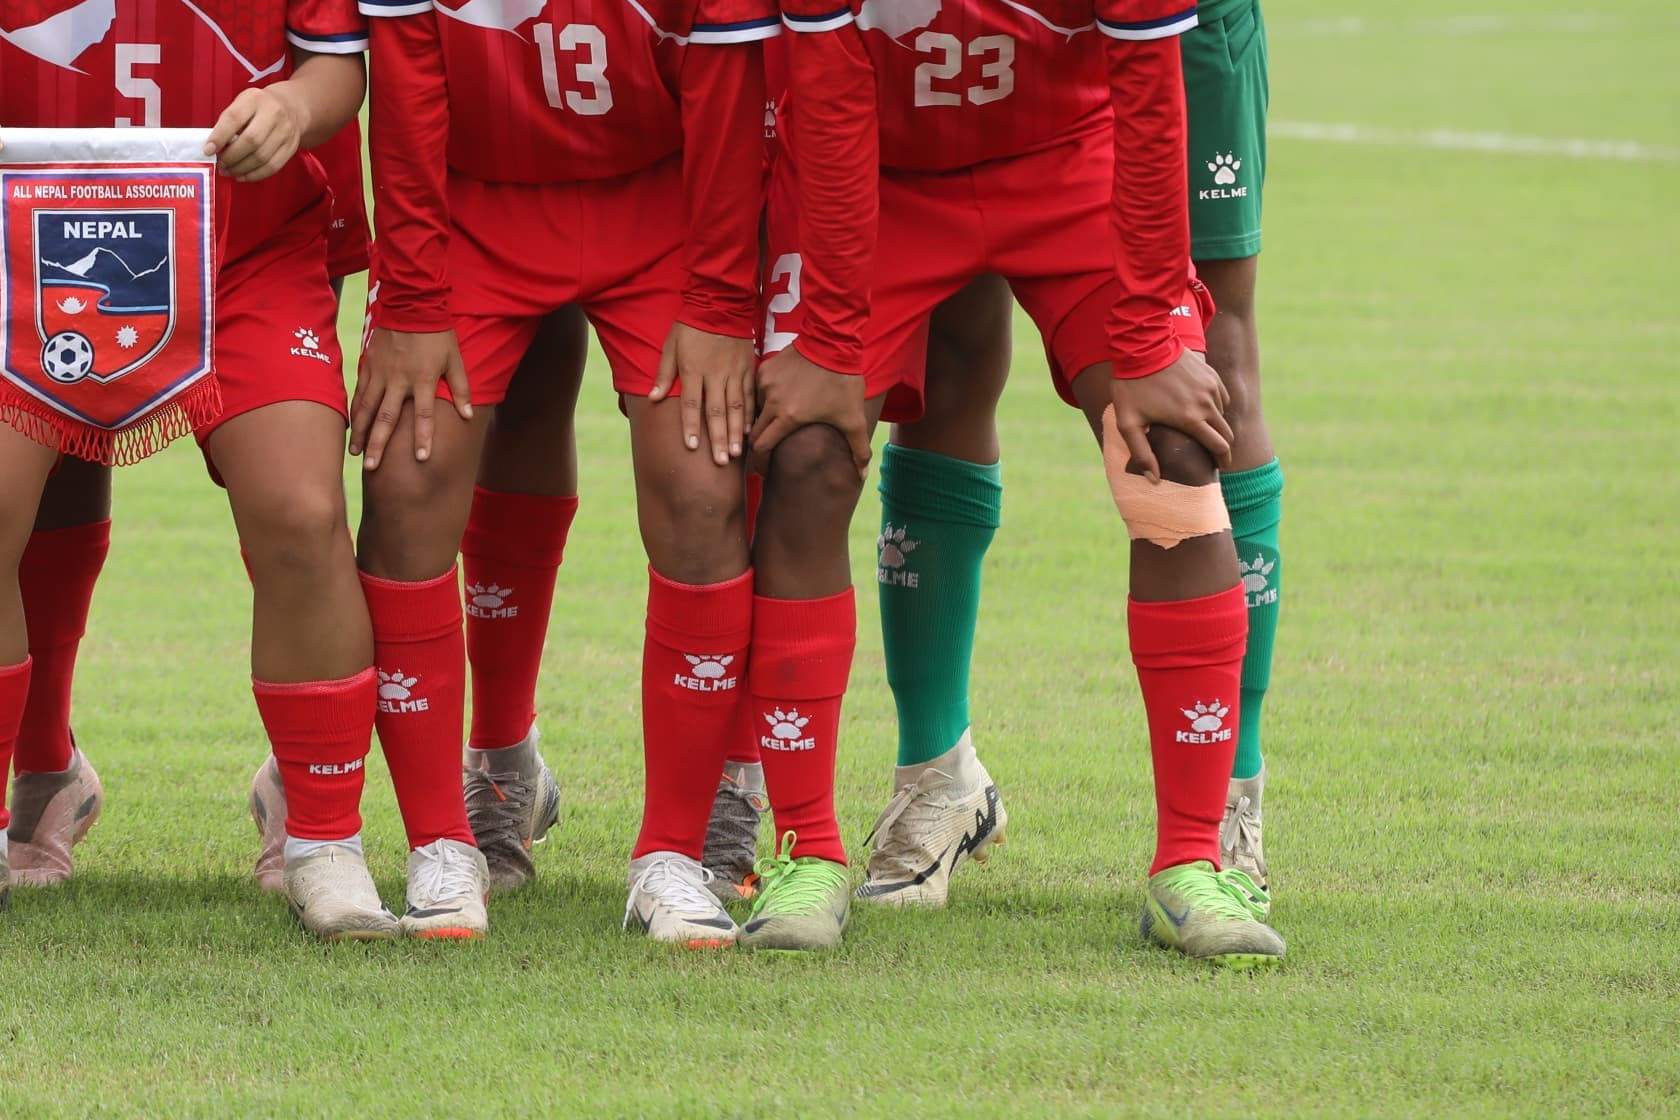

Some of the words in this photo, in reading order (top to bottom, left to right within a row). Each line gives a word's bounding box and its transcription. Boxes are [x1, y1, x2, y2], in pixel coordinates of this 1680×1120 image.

[533, 23, 613, 115] 13
[914, 31, 1015, 107] 23
[115, 43, 161, 128] 5
[13, 185, 32, 199] ALL
[35, 185, 68, 199] NEPAL
[70, 185, 123, 199] FOOTBALL
[125, 184, 195, 199] ASSOCIATION
[1199, 186, 1248, 200] KELME
[63, 221, 143, 239] NEPAL
[290, 347, 331, 364] KELME
[674, 674, 737, 692] KELME
[762, 734, 815, 751] KELME
[1176, 729, 1232, 744] KELME
[310, 758, 364, 776] KELME
